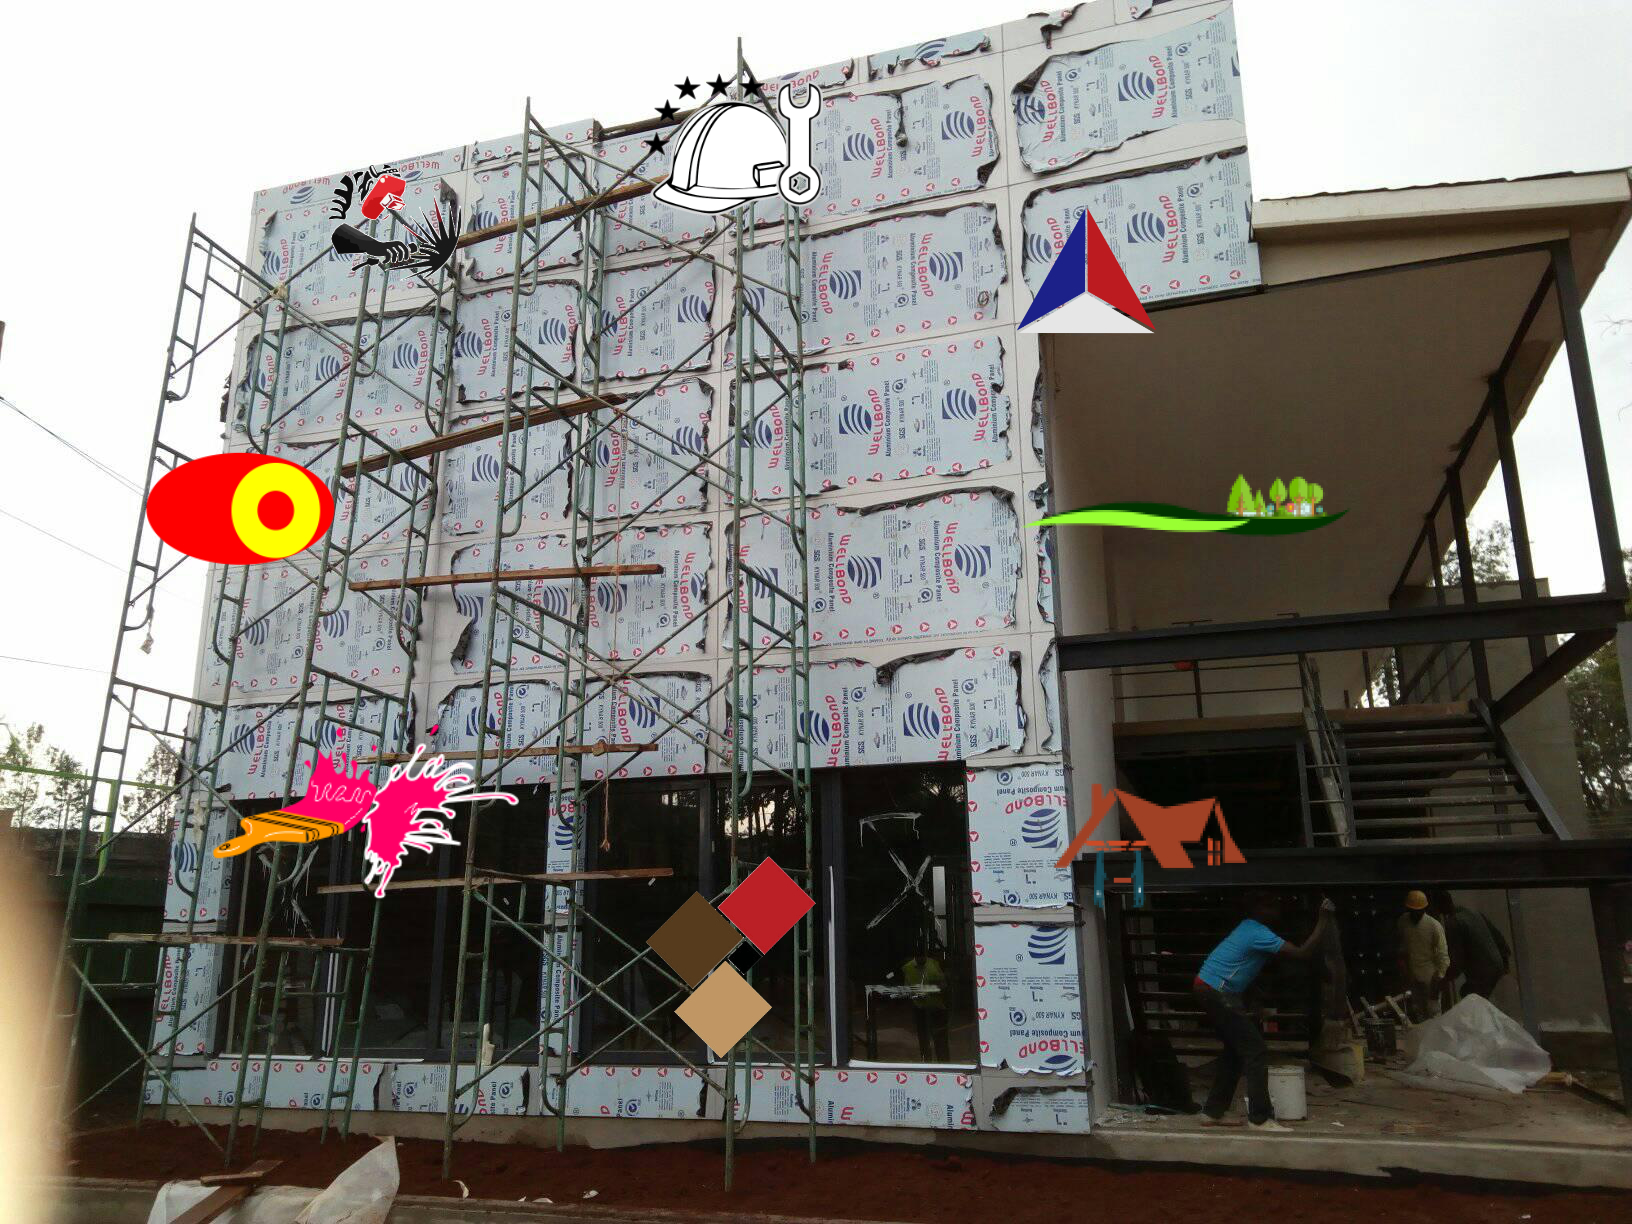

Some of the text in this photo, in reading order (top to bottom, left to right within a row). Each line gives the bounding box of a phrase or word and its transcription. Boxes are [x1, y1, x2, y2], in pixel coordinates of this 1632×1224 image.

[1041, 80, 1058, 143] WELLBOND
[1149, 56, 1168, 118] WELLBOND
[870, 118, 886, 178] WELLBOND
[970, 96, 986, 157] WELLBOND
[1160, 196, 1180, 262] WELLBOND
[818, 252, 834, 314] WELLBOND
[918, 233, 934, 297] WELLBOND
[413, 330, 428, 386] WELLBOND
[477, 318, 492, 376] WELLBOND
[768, 404, 784, 468] WELLBOND
[868, 389, 884, 456] WELLBOND
[972, 374, 988, 441] WELLBOND
[933, 521, 941, 551] Aluminium
[942, 522, 960, 594] WELLBOND
[679, 552, 696, 619] WELLBOND
[835, 534, 852, 604] WELLBOND
[826, 696, 841, 767] WELLBOND
[936, 688, 952, 761] WELLBOND
[996, 788, 1016, 796] Panel
[1055, 768, 1064, 776] GS
[1006, 794, 1068, 814] ELLBOND
[1064, 892, 1074, 900] GS
[1072, 1012, 1080, 1020] GS
[1019, 1040, 1084, 1058] ELLBOND
